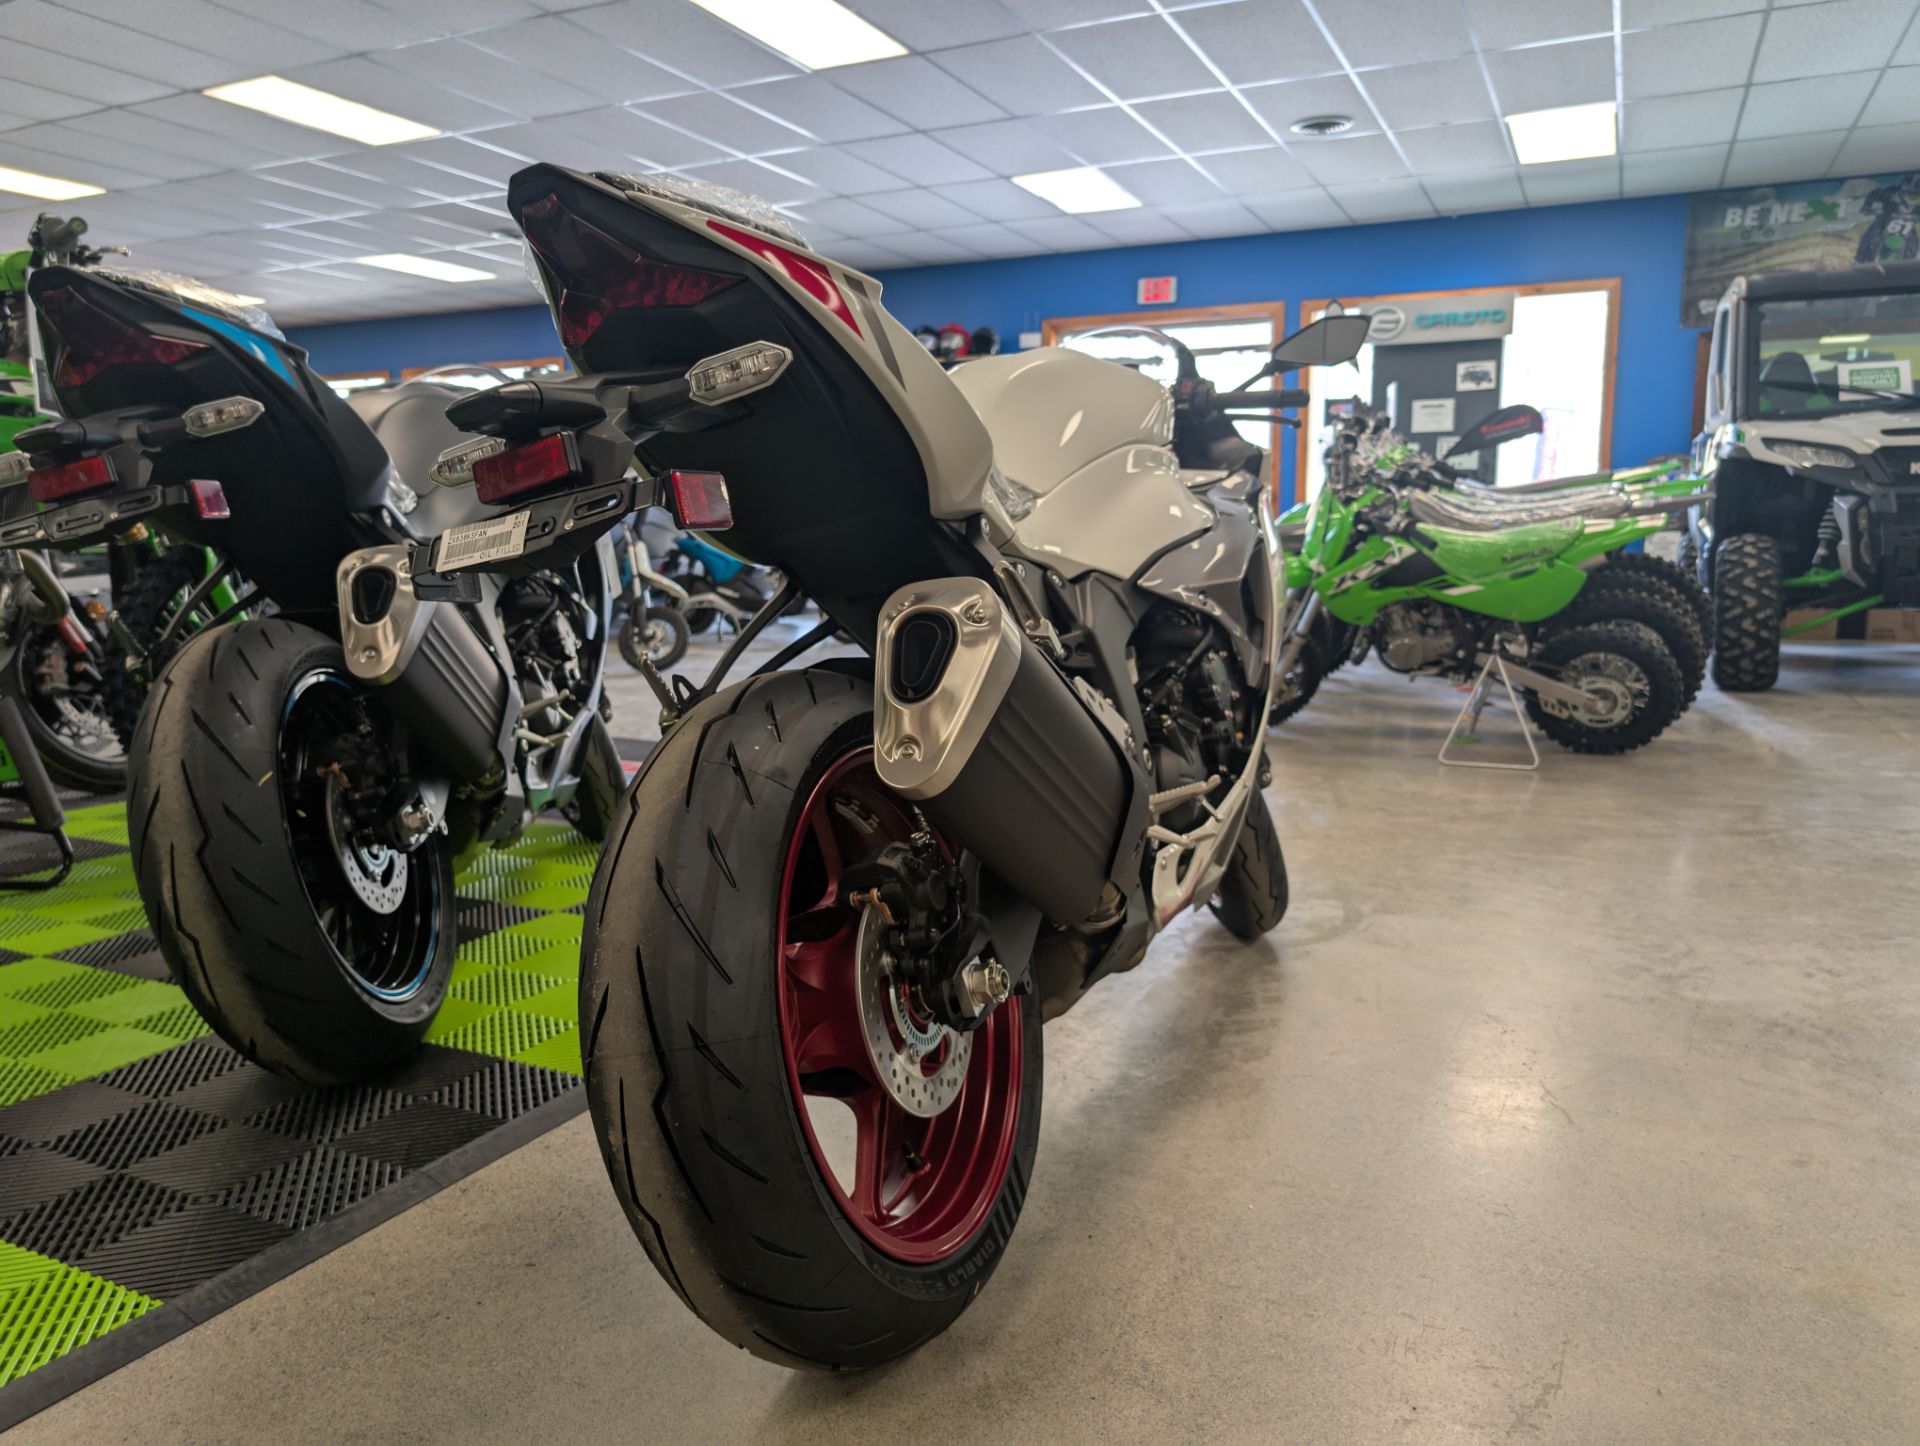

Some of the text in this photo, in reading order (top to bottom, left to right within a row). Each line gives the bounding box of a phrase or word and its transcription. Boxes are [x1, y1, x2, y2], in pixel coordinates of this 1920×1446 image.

[1724, 205, 1761, 228] BE
[1887, 219, 1914, 235] 61
[1144, 278, 1171, 302] EXIT
[479, 543, 521, 560] OIL FILLED
[947, 1238, 997, 1288] DIABLO
